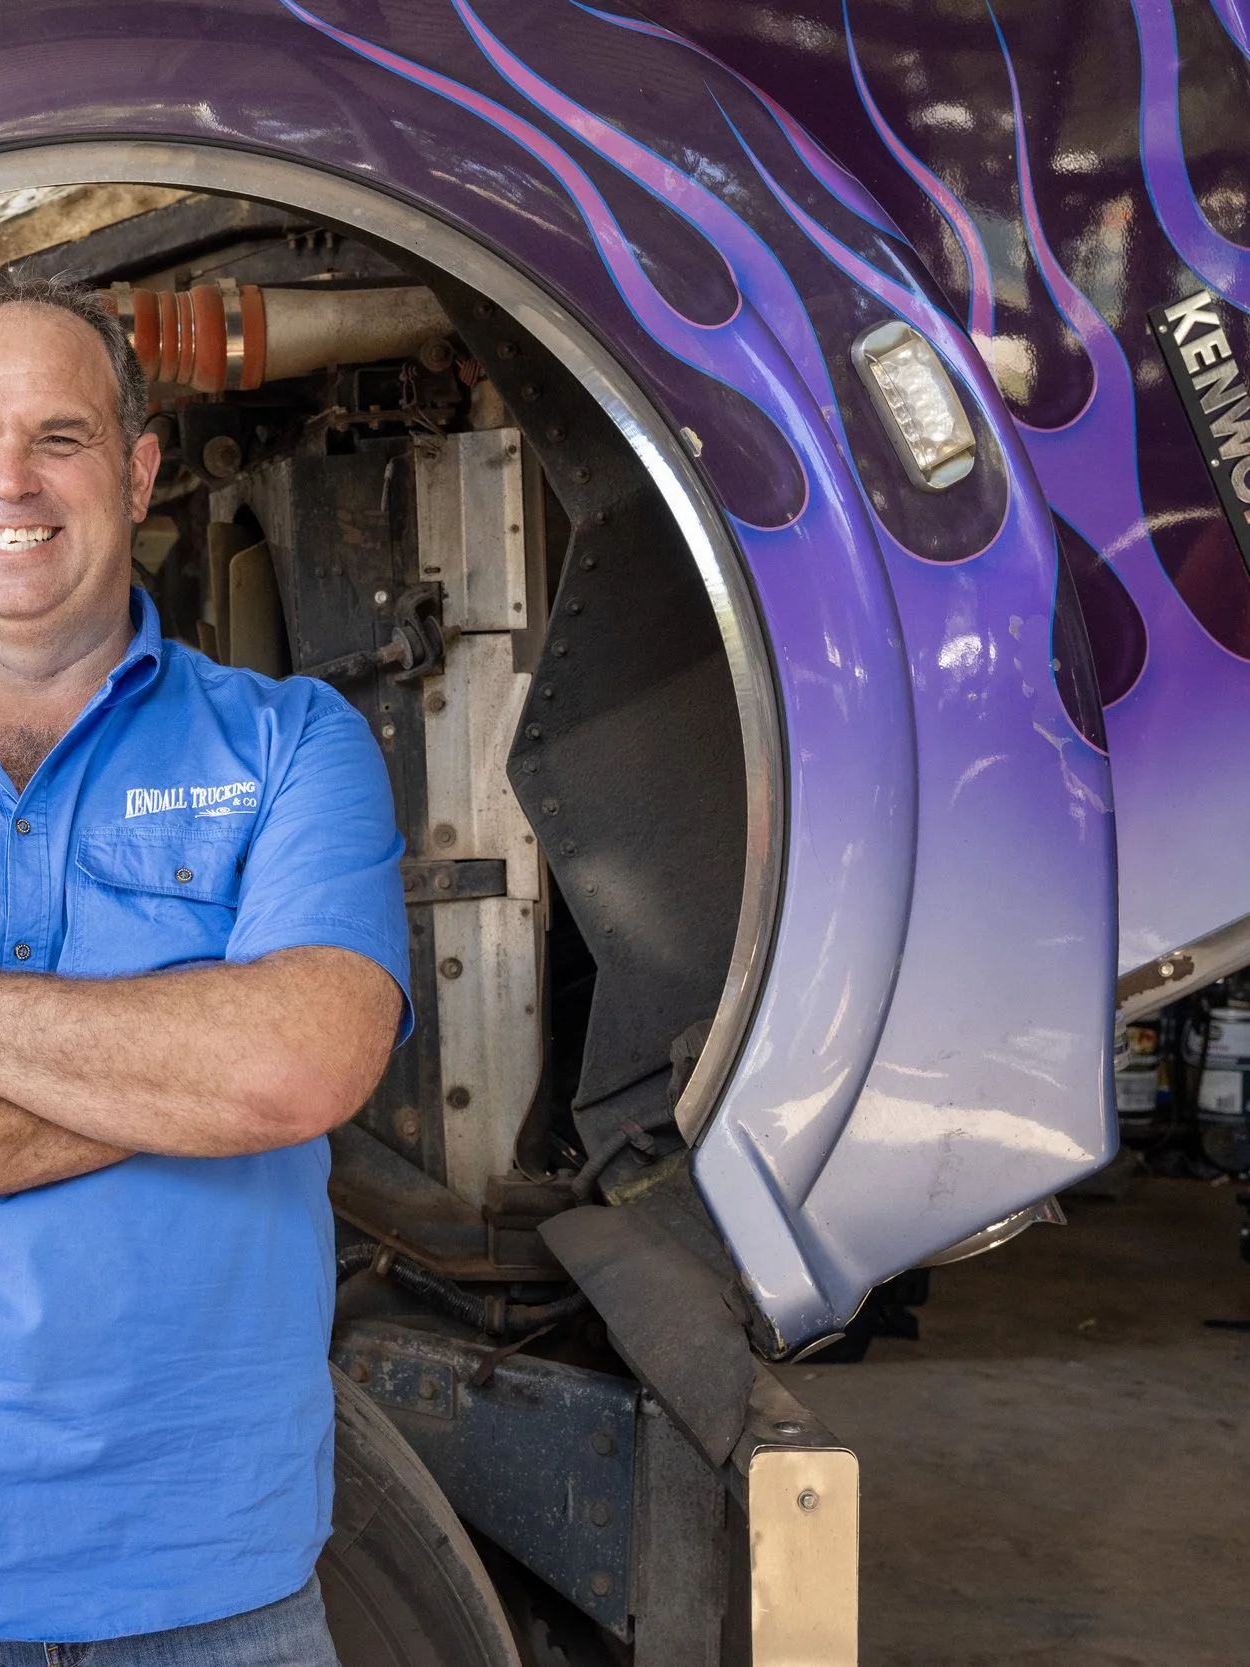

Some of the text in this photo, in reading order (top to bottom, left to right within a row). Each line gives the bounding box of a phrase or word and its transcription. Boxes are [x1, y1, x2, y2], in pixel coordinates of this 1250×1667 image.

[125, 781, 256, 818] KENDALL TRUCKING
[232, 797, 242, 806] &
